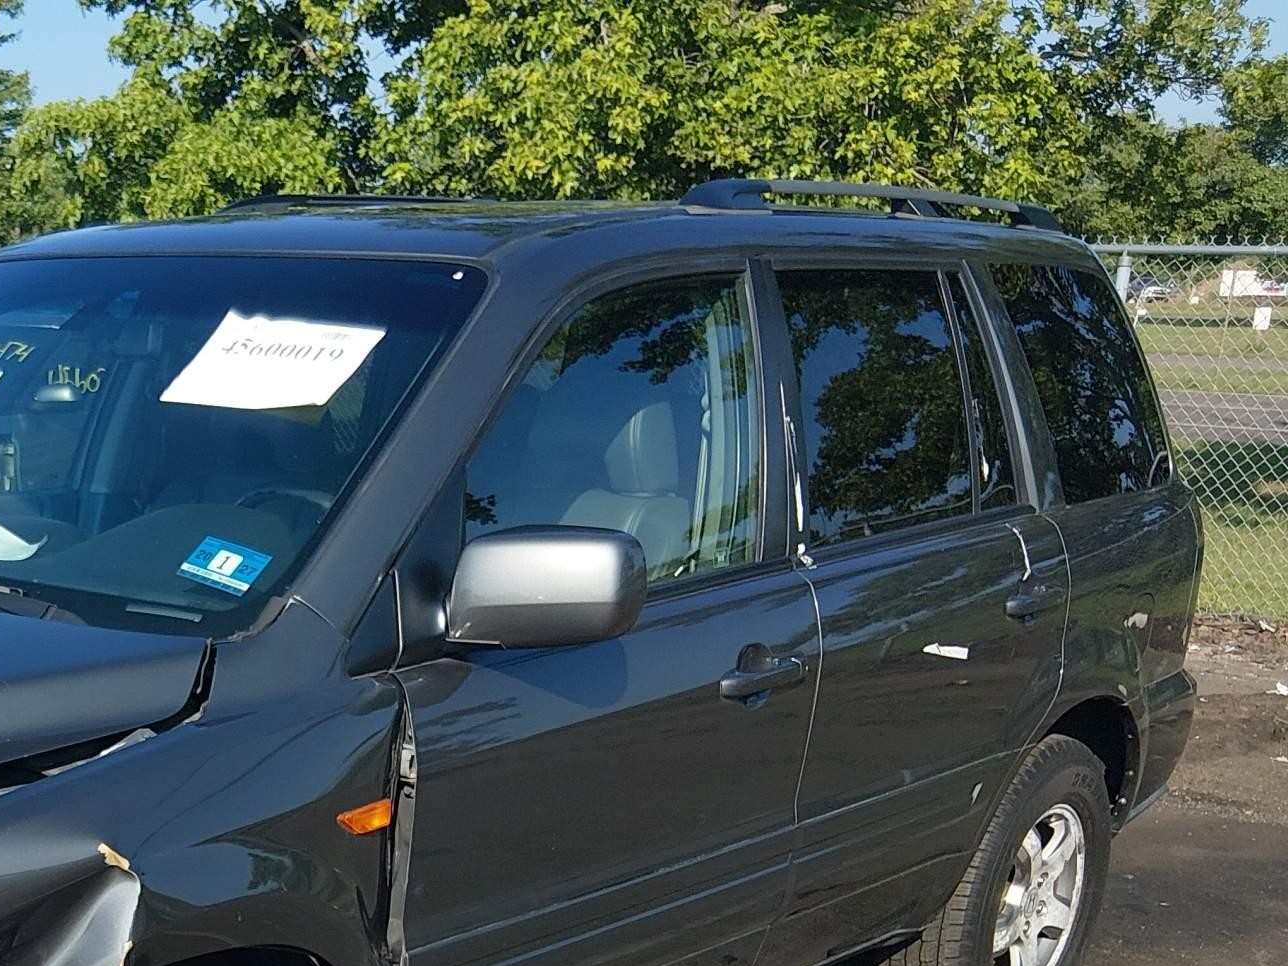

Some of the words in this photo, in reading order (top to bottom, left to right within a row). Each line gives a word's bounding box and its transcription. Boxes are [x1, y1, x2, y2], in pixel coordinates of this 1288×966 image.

[221, 337, 345, 361] 45600019
[194, 549, 214, 562] 20
[216, 555, 231, 570] 1
[237, 564, 258, 577] 27
